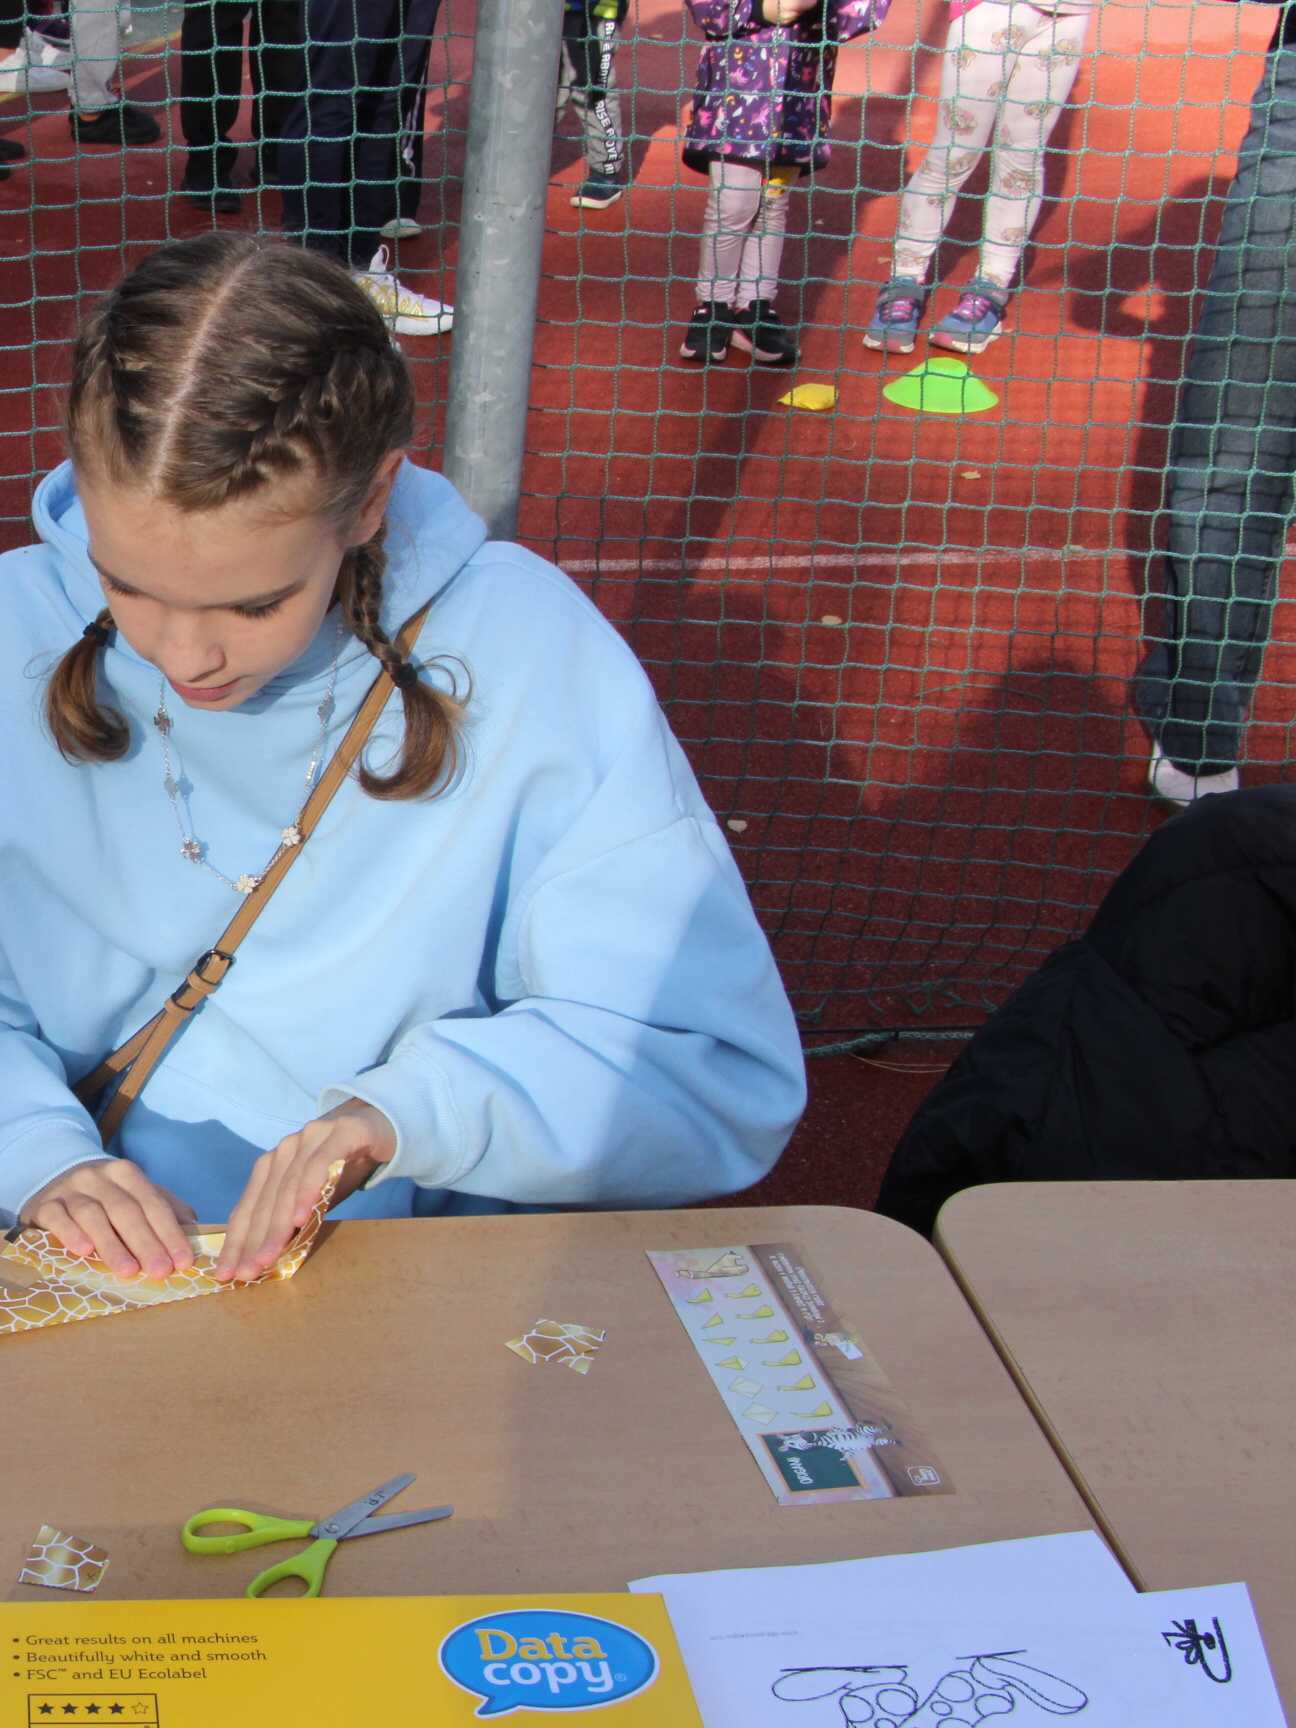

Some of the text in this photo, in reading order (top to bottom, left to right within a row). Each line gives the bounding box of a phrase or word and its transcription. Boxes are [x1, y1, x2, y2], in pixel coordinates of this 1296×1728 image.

[603, 21, 615, 52] RIE
[595, 100, 611, 127] RISE
[605, 127, 618, 160] AOVE
[25, 1632, 259, 1646] Great results on all machines
[474, 1628, 608, 1661] Data
[26, 1649, 267, 1664] Beautifully white and smooth
[72, 1668, 103, 1680] and
[109, 1668, 133, 1680] EU
[138, 1667, 208, 1680] Ecolabel
